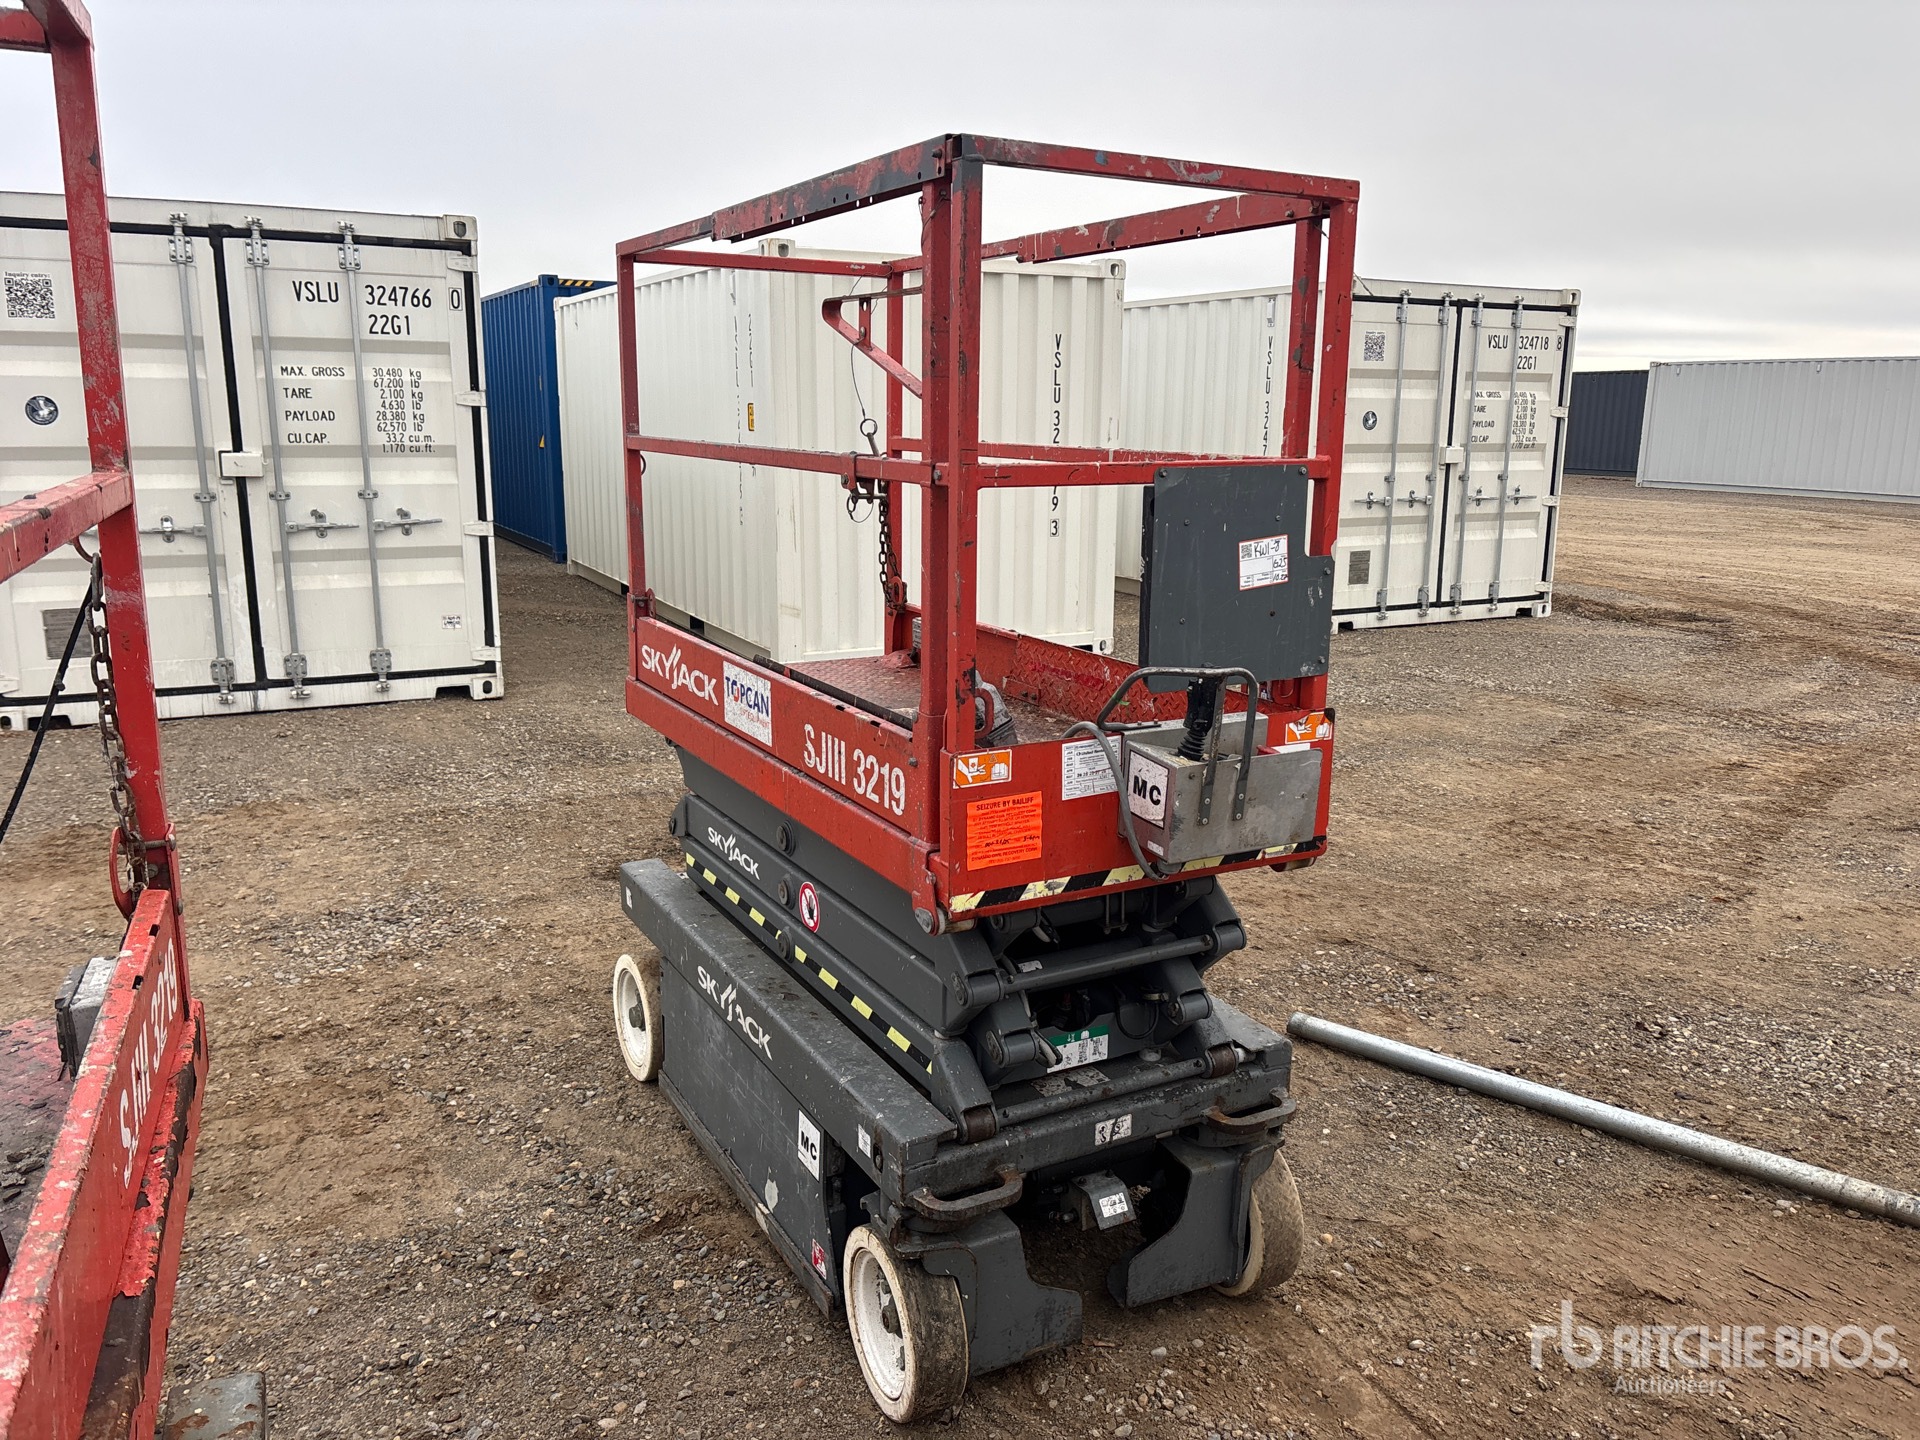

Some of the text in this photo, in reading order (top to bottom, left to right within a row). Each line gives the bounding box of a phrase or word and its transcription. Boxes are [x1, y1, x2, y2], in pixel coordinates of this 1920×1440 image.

[292, 280, 339, 303] VSLU
[364, 284, 432, 308] 324766
[368, 314, 411, 335] 22G1
[1488, 335, 1508, 349] VSLU
[1518, 336, 1549, 350] 324718
[1053, 334, 1062, 403] VSLU
[1516, 356, 1537, 370] 22G1
[280, 366, 421, 381] MAX. GROSS 30.480 kg
[373, 378, 420, 389] 67.200 lb
[283, 388, 423, 401] TARE 2.100 kg
[381, 400, 421, 410] 4.630 lb
[1474, 405, 1486, 413] TARE
[285, 410, 425, 423] PAYLOAD 28.380 kg
[1472, 420, 1494, 428] PAYLOAD
[377, 422, 423, 432] 62.570 lb
[386, 433, 405, 443] 33.2
[408, 434, 435, 443] cu.m.
[383, 444, 436, 453] 1.170 cu.ft.
[641, 643, 719, 706] SKYJACK
[725, 676, 769, 717] TOPCAN
[803, 723, 906, 816] SJIII 3219
[1133, 775, 1162, 806] MC
[976, 801, 1001, 811] SEIZURE
[1002, 799, 1011, 807] BY
[707, 826, 760, 880] SKYJACK
[151, 937, 178, 1074] 3219
[697, 965, 773, 1061] SKYJACK
[801, 1130, 818, 1161] MC
